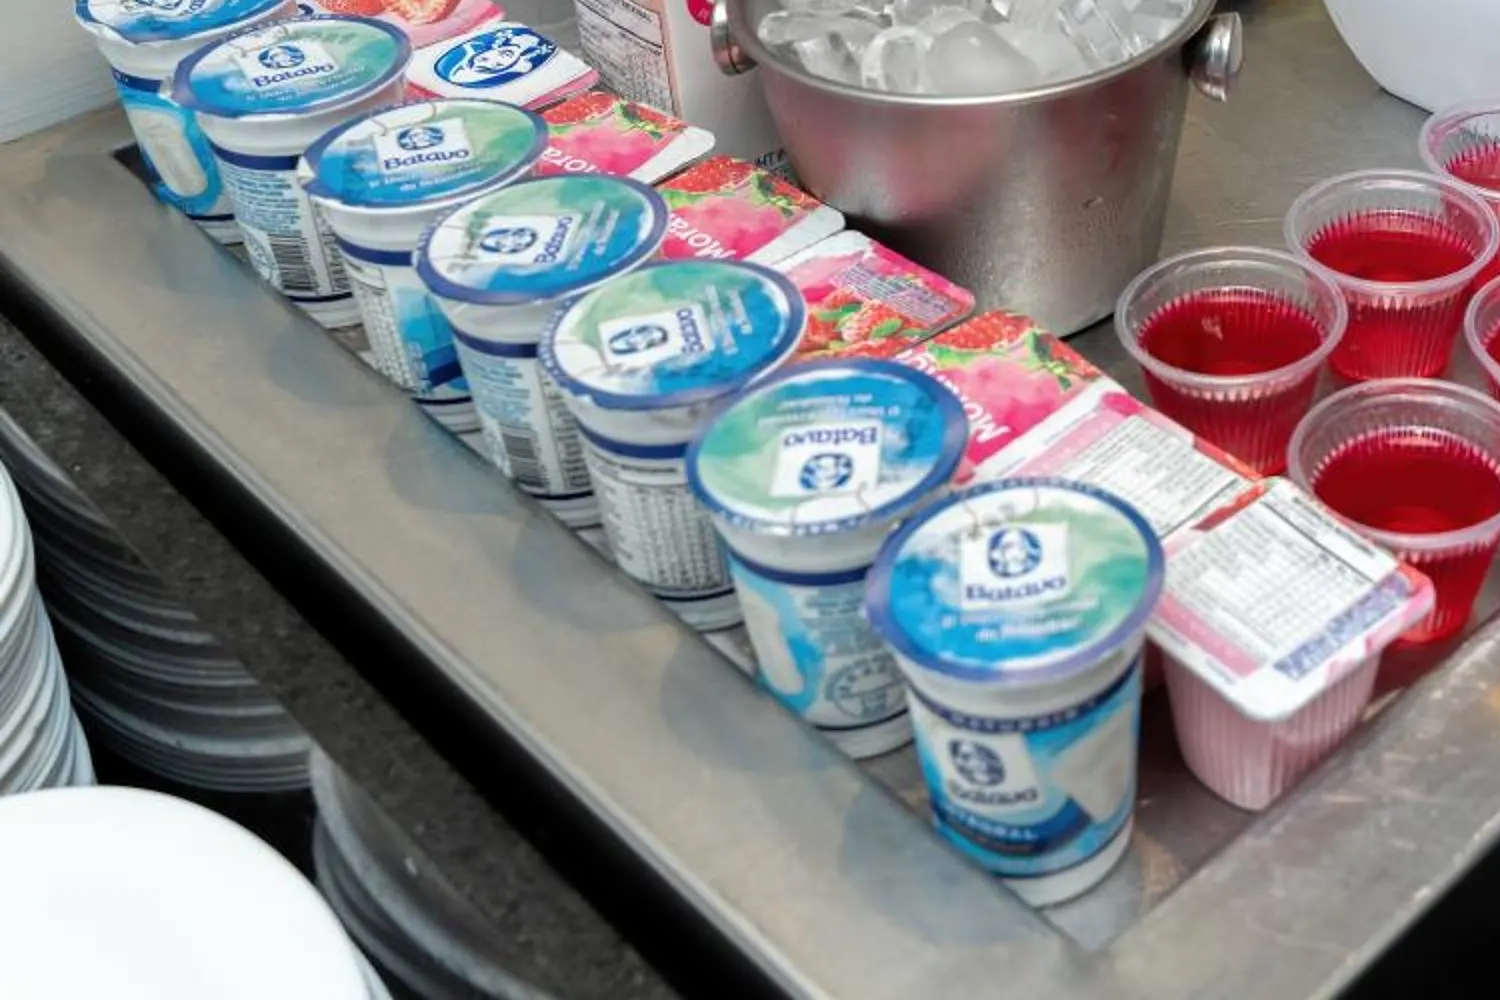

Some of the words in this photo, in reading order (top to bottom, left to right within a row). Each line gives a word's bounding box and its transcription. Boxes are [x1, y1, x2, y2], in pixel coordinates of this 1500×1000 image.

[253, 63, 334, 87] Batavo
[384, 149, 470, 170] Batavo
[783, 426, 879, 447] Batavo
[965, 576, 1067, 601] Batavo
